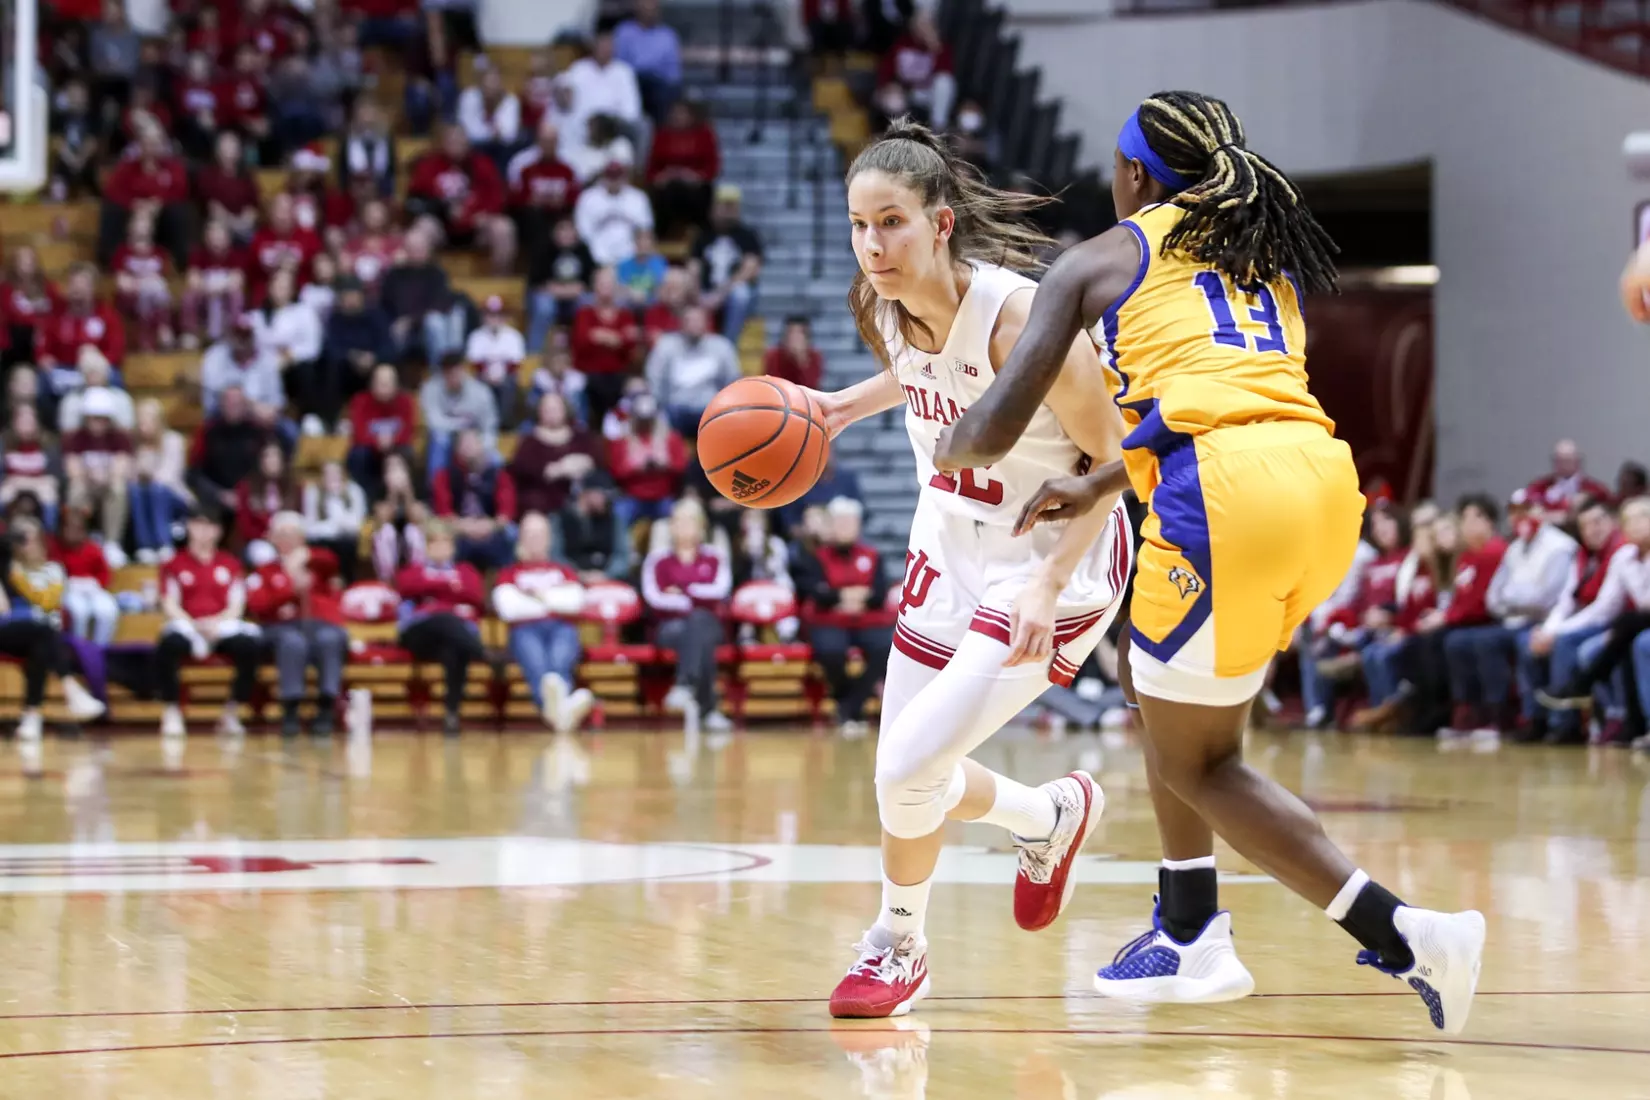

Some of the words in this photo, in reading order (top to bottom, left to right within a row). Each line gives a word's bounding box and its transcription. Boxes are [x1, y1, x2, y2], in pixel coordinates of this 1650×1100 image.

[1191, 269, 1288, 355] 13
[733, 479, 771, 499] adidas
[928, 454, 1003, 506] 2
